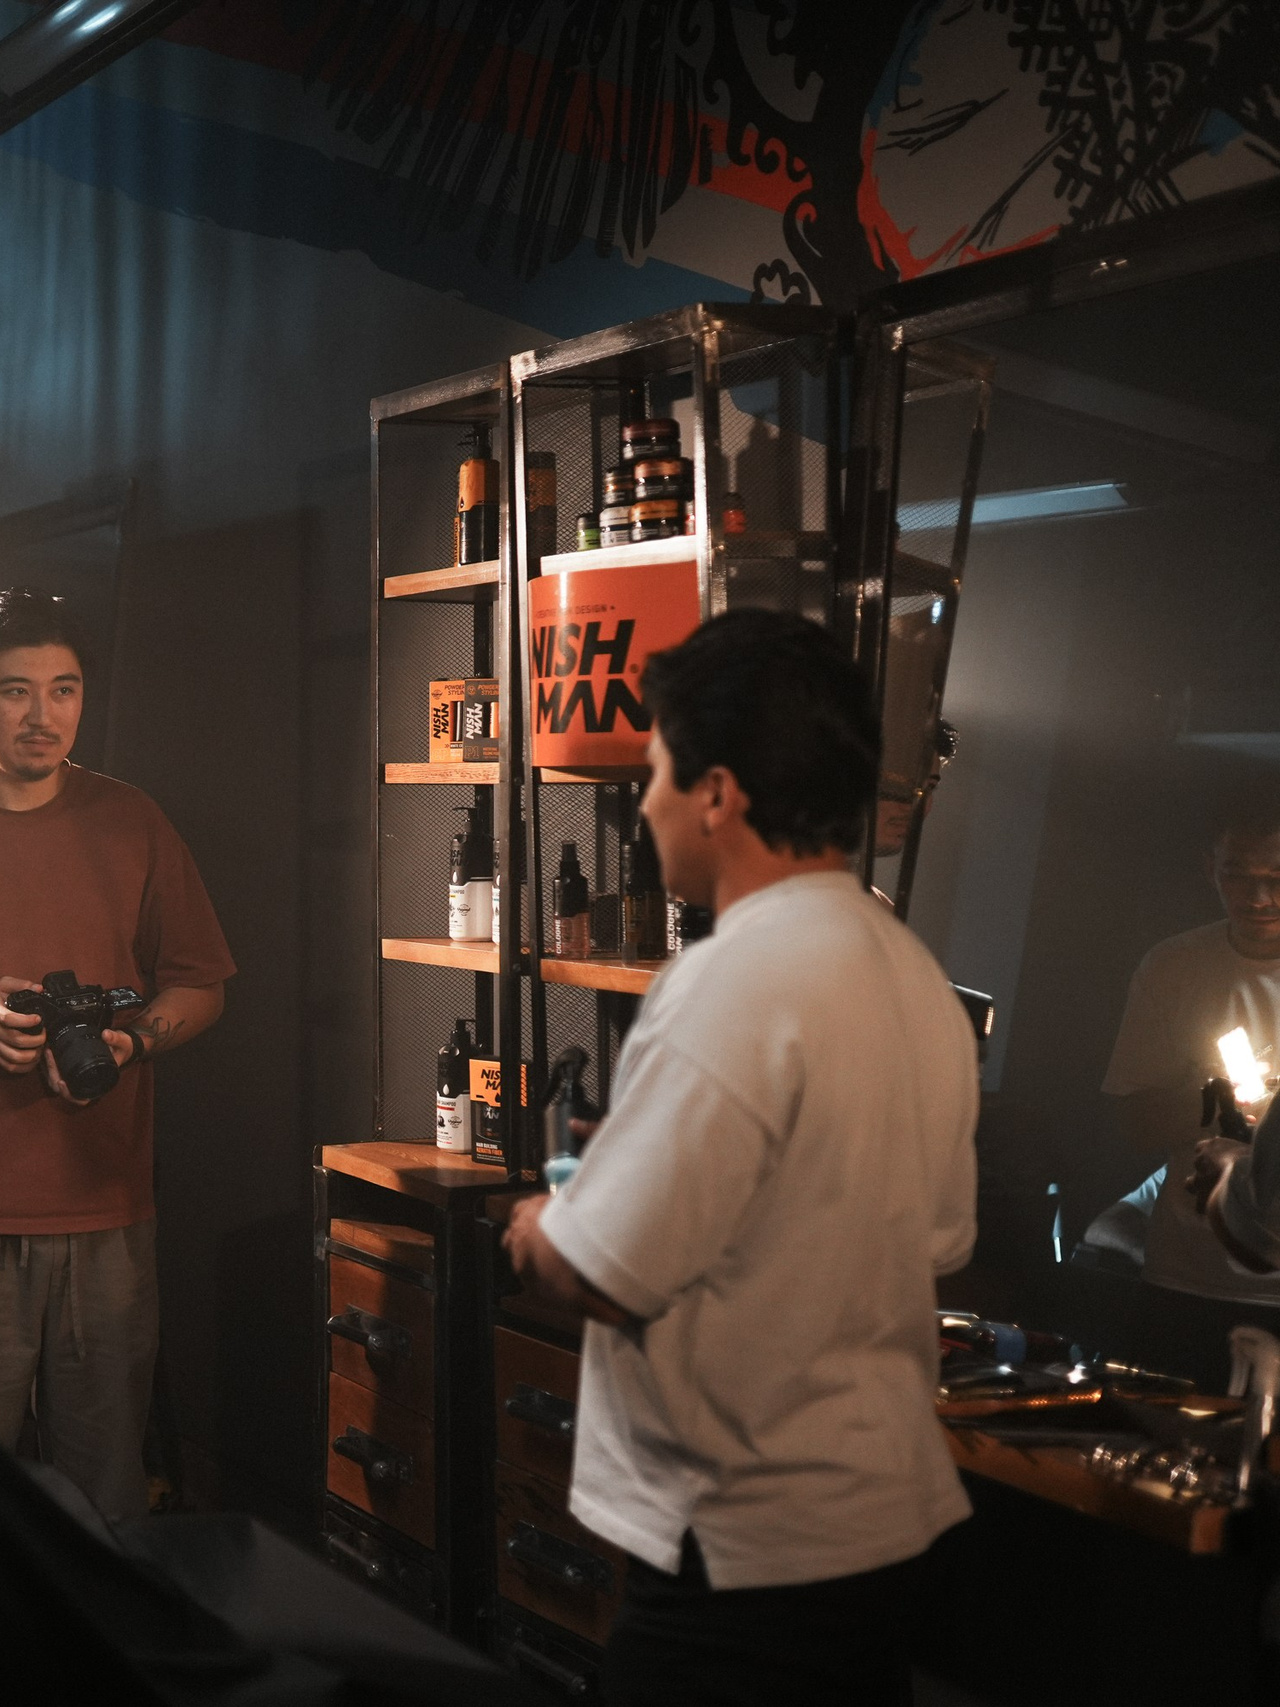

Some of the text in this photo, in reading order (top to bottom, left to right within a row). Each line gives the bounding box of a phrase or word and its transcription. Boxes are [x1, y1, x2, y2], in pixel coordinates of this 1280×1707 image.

[533, 619, 636, 678] NISH
[433, 707, 441, 739] NISH
[441, 703, 449, 734] MAN
[465, 707, 475, 740] NISH
[474, 702, 483, 735] MAN
[666, 902, 676, 951] COLOGNE
[481, 1068, 501, 1080] NIS
